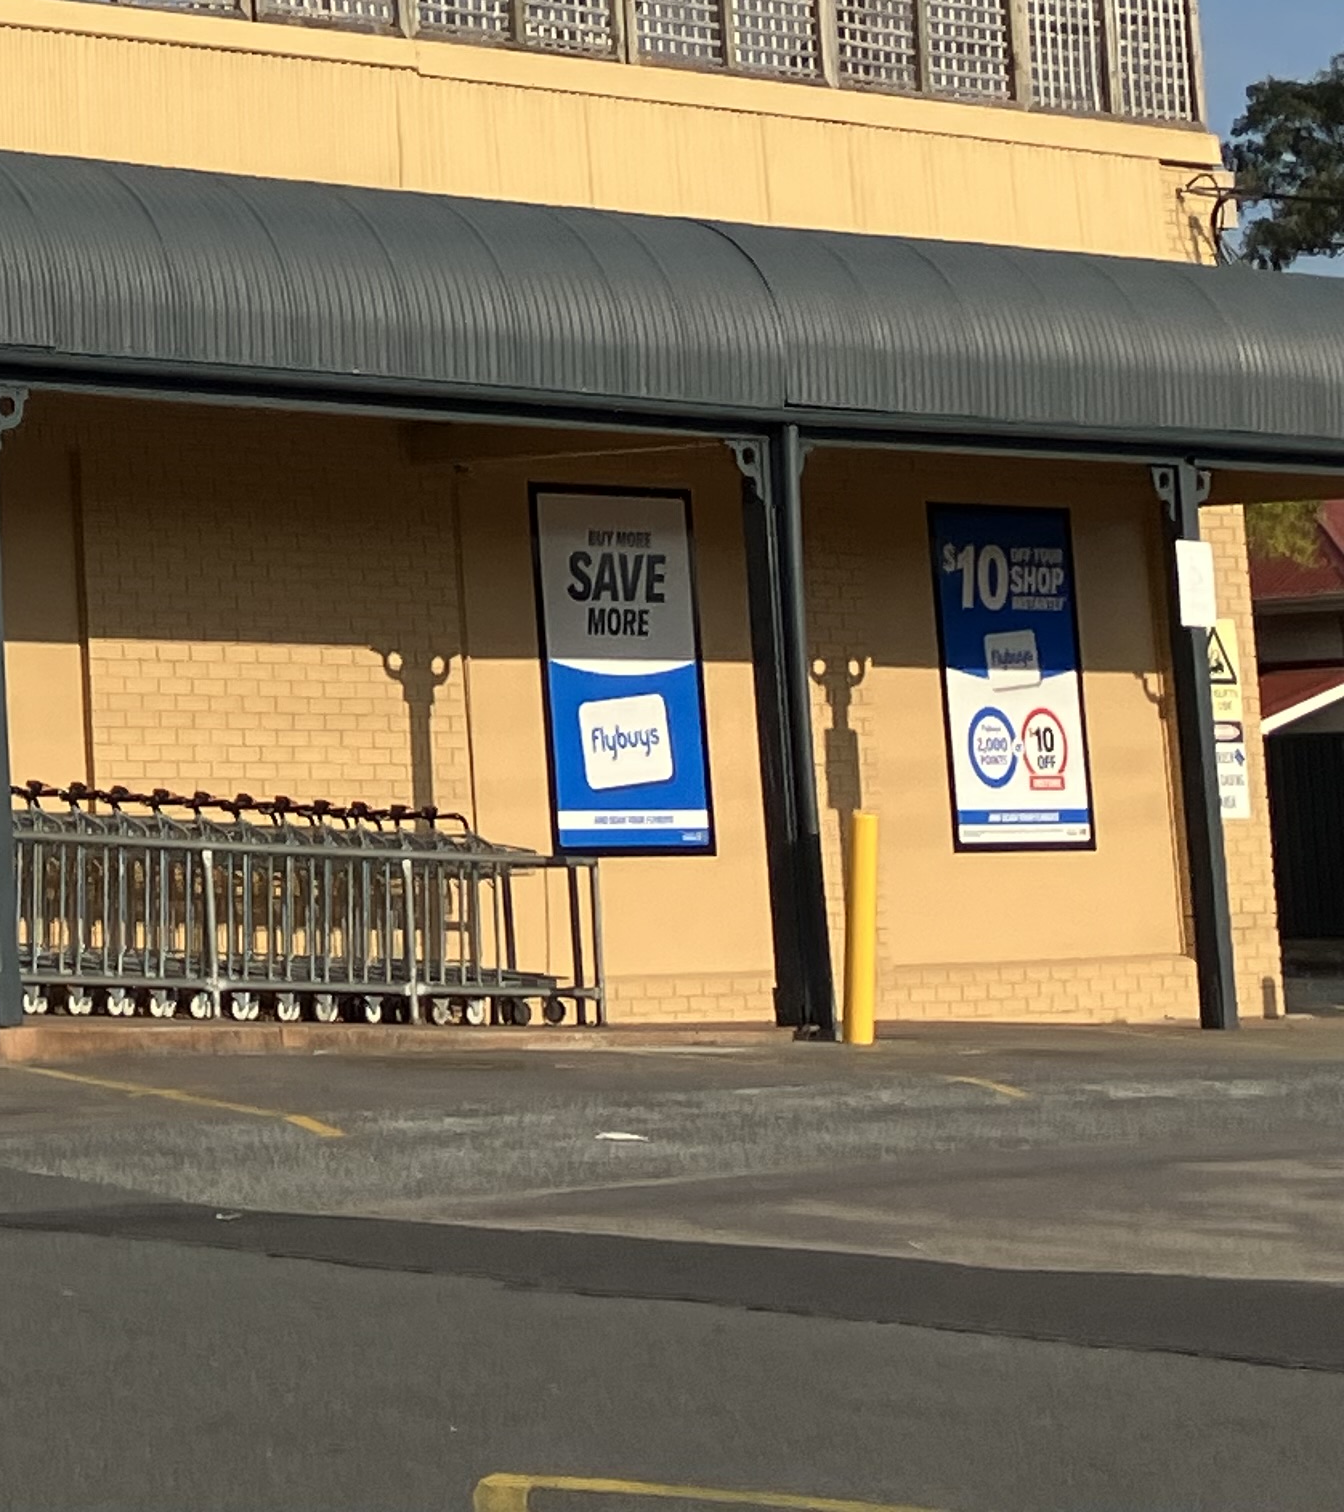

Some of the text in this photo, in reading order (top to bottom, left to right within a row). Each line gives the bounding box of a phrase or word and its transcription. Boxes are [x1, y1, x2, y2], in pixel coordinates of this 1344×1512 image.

[567, 551, 667, 604] SAVE
[942, 542, 1009, 611] $10
[1010, 565, 1064, 594] SHOP
[587, 607, 650, 637] MORE
[591, 724, 660, 761] flybuys
[1028, 726, 1054, 753] $10
[1037, 755, 1056, 769] OFF
